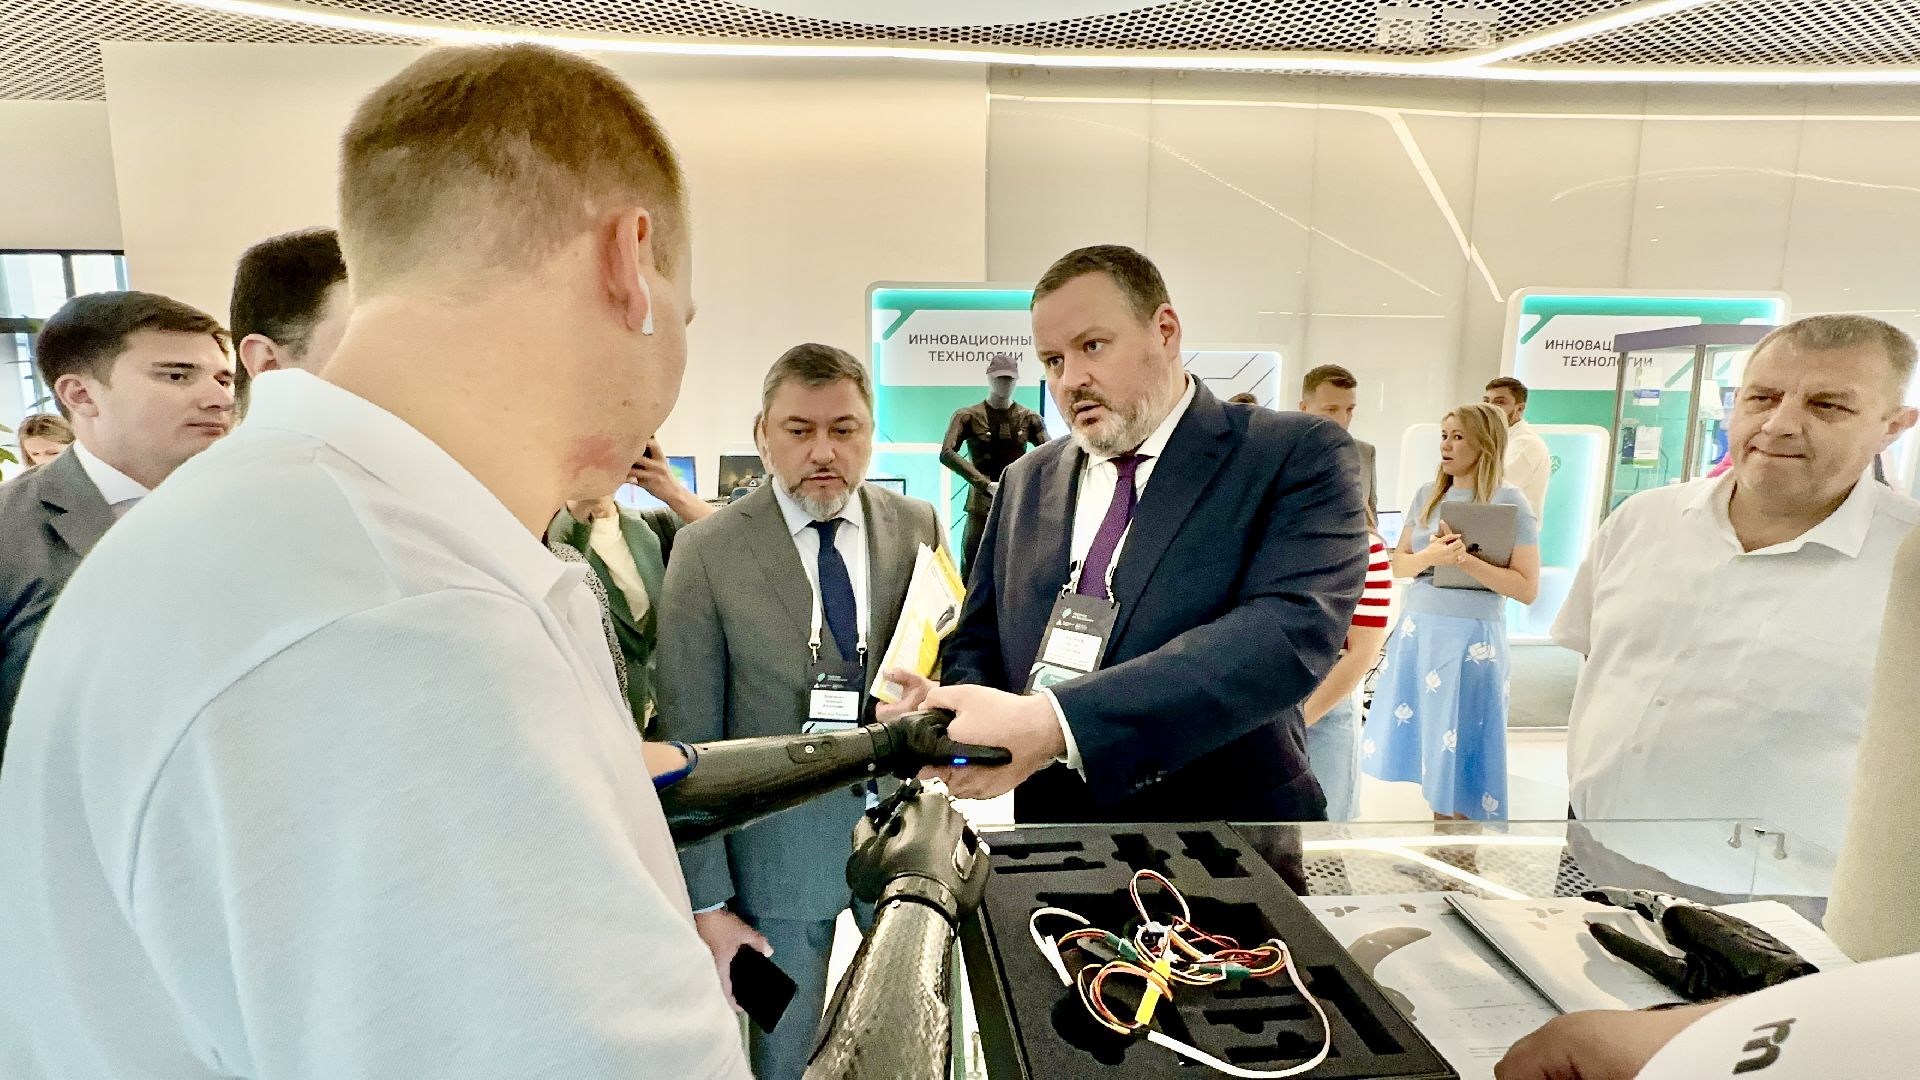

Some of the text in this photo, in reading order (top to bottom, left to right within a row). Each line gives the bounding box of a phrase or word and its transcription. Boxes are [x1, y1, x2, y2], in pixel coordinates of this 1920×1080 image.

[908, 334, 1032, 347] ИННОВАЦИОННЫ
[1545, 340, 1612, 352] ИННОВАЦ
[928, 351, 1023, 362] ТЕХНОЛОИ
[1562, 356, 1653, 367] ТЕХНОЛГИИ
